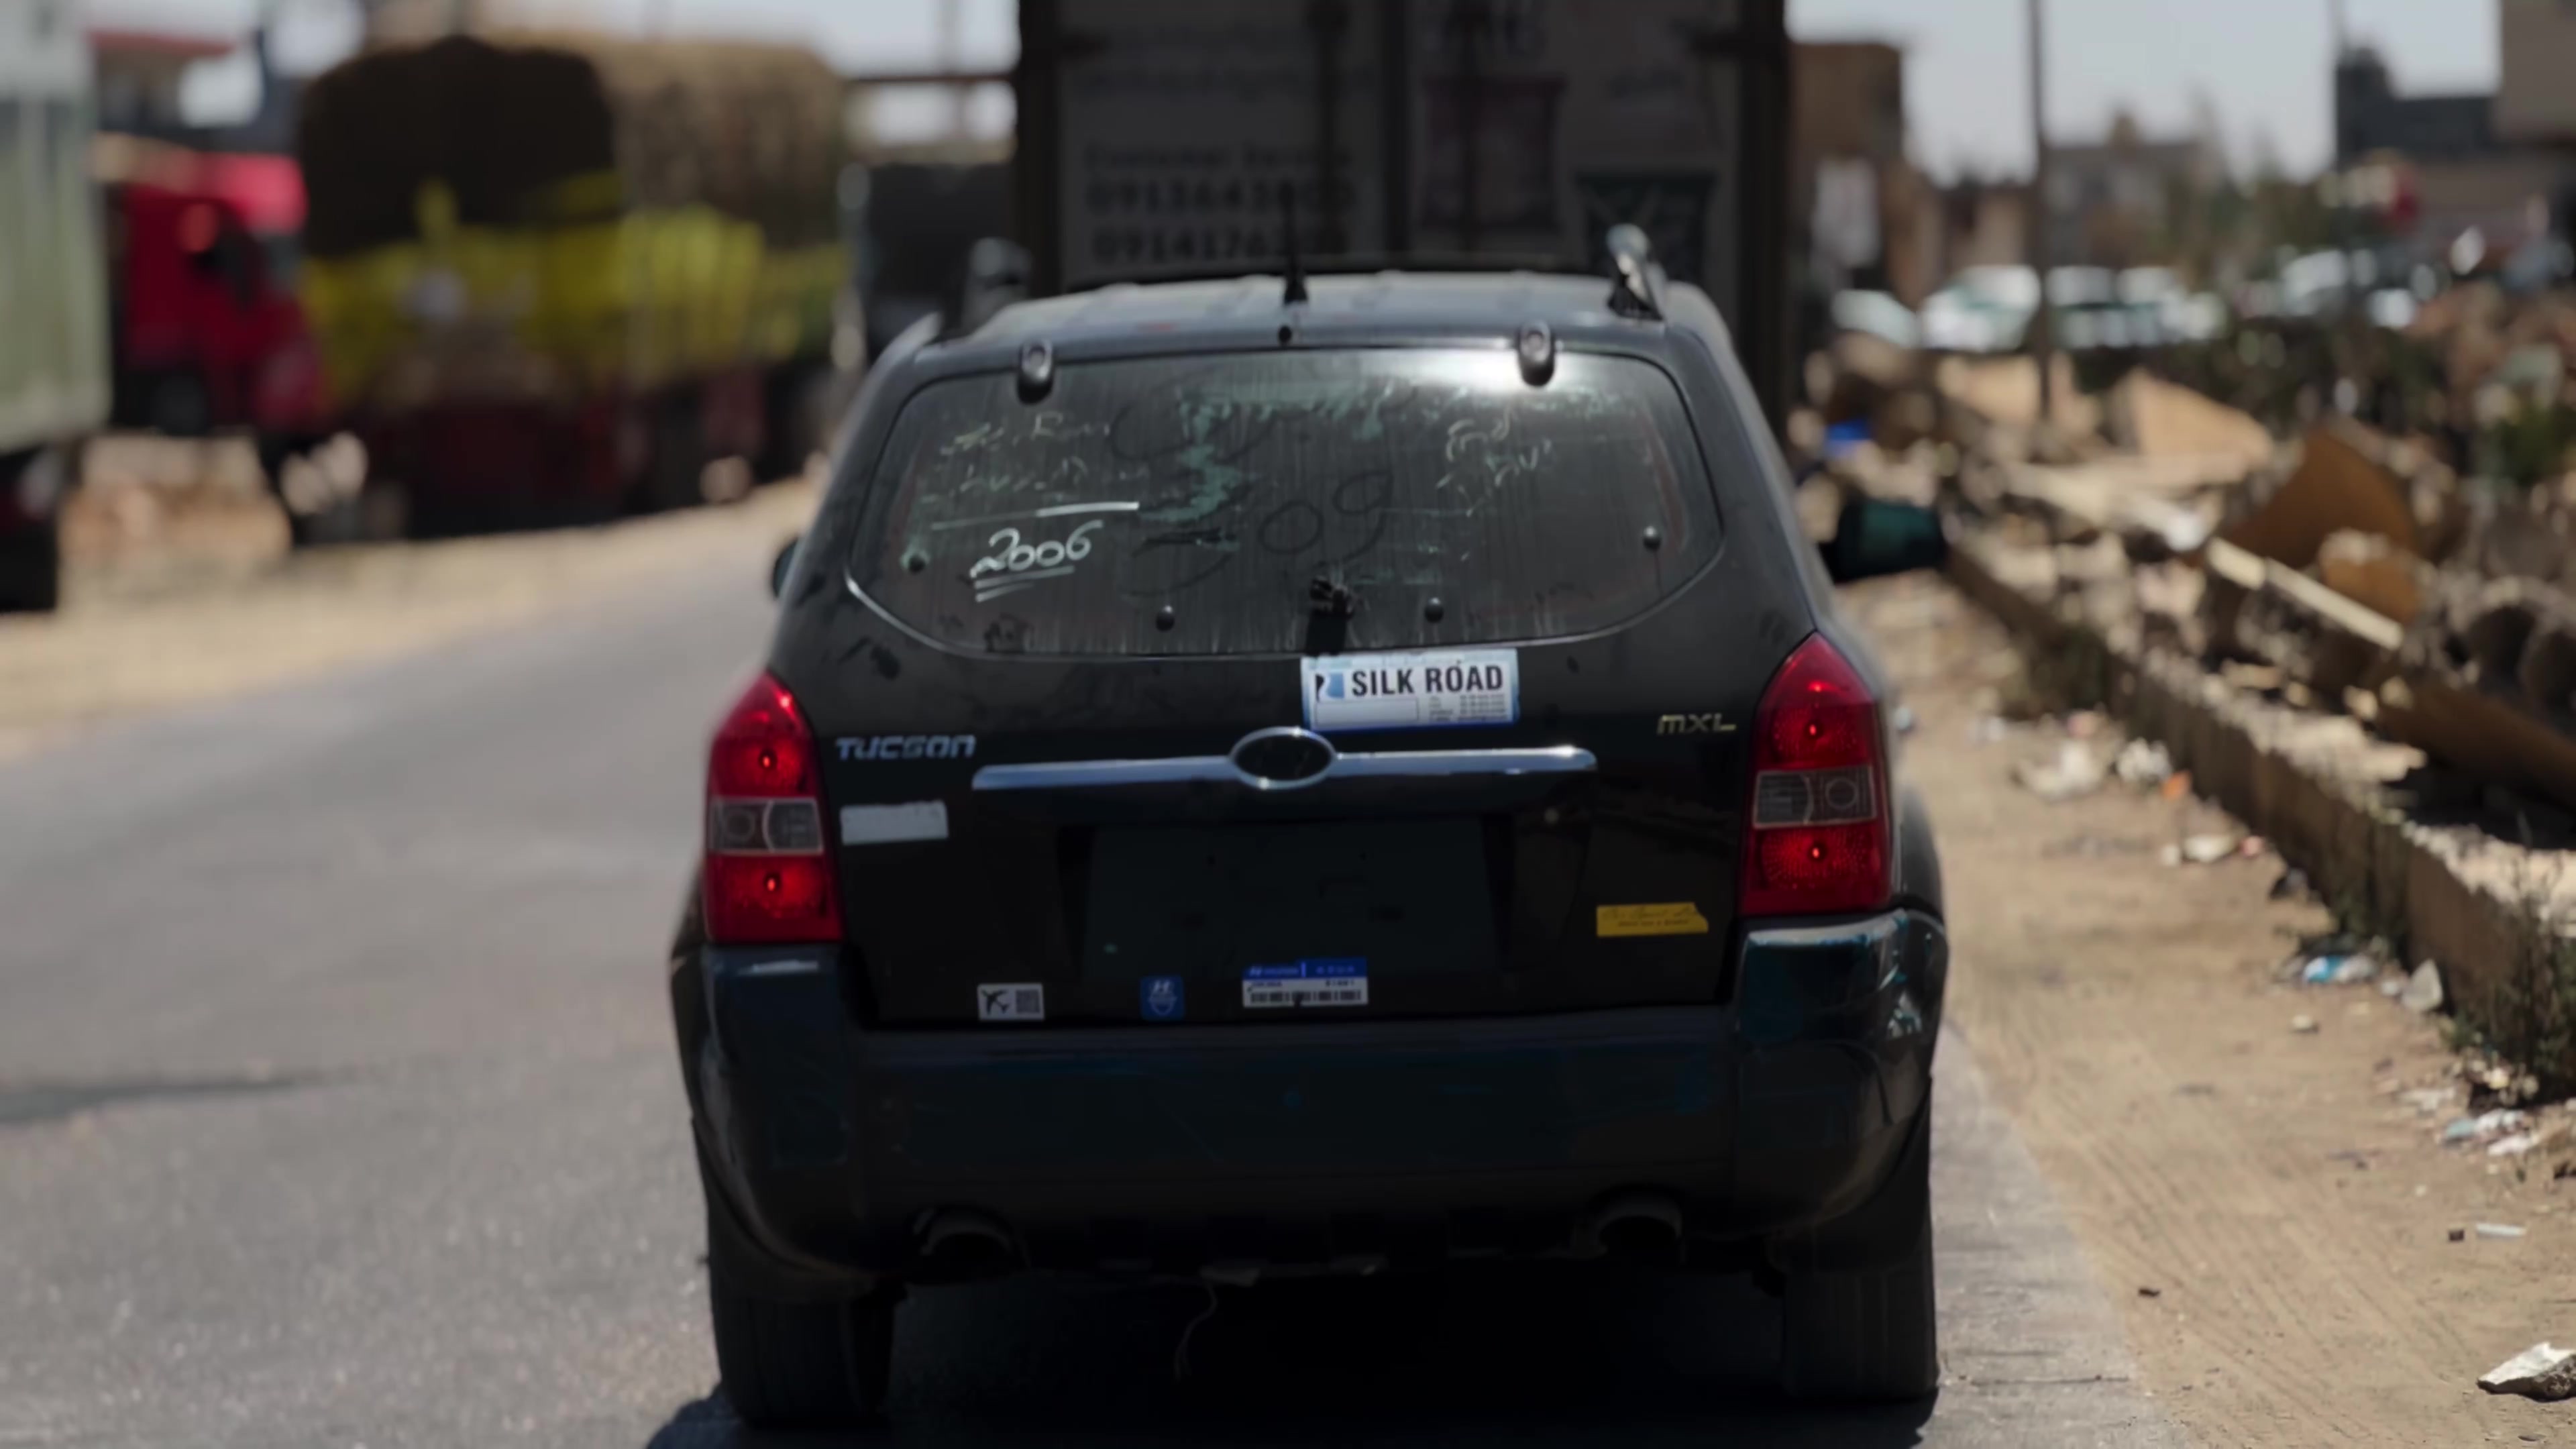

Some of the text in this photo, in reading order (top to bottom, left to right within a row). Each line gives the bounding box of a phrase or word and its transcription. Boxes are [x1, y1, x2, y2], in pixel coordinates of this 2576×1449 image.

[970, 520, 1104, 578] 2006
[1351, 665, 1503, 696] SILK ROAD
[1656, 712, 1736, 735] MXL
[836, 735, 976, 760] TUCSON
